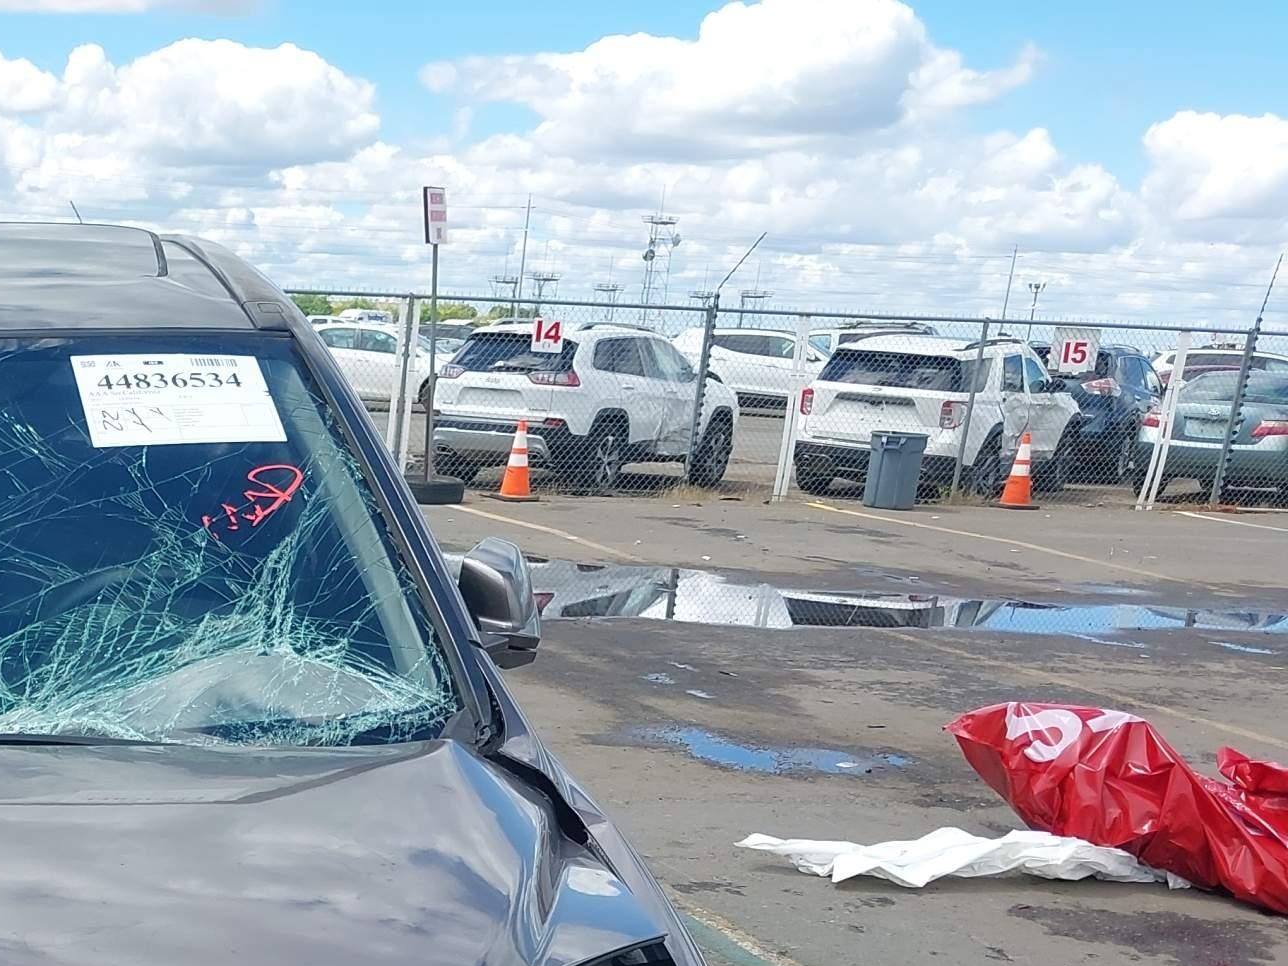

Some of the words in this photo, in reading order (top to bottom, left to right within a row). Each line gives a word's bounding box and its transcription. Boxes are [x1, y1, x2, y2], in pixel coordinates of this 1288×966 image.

[535, 320, 562, 344] 14
[1062, 341, 1088, 364] 15
[97, 372, 243, 390] 44836534
